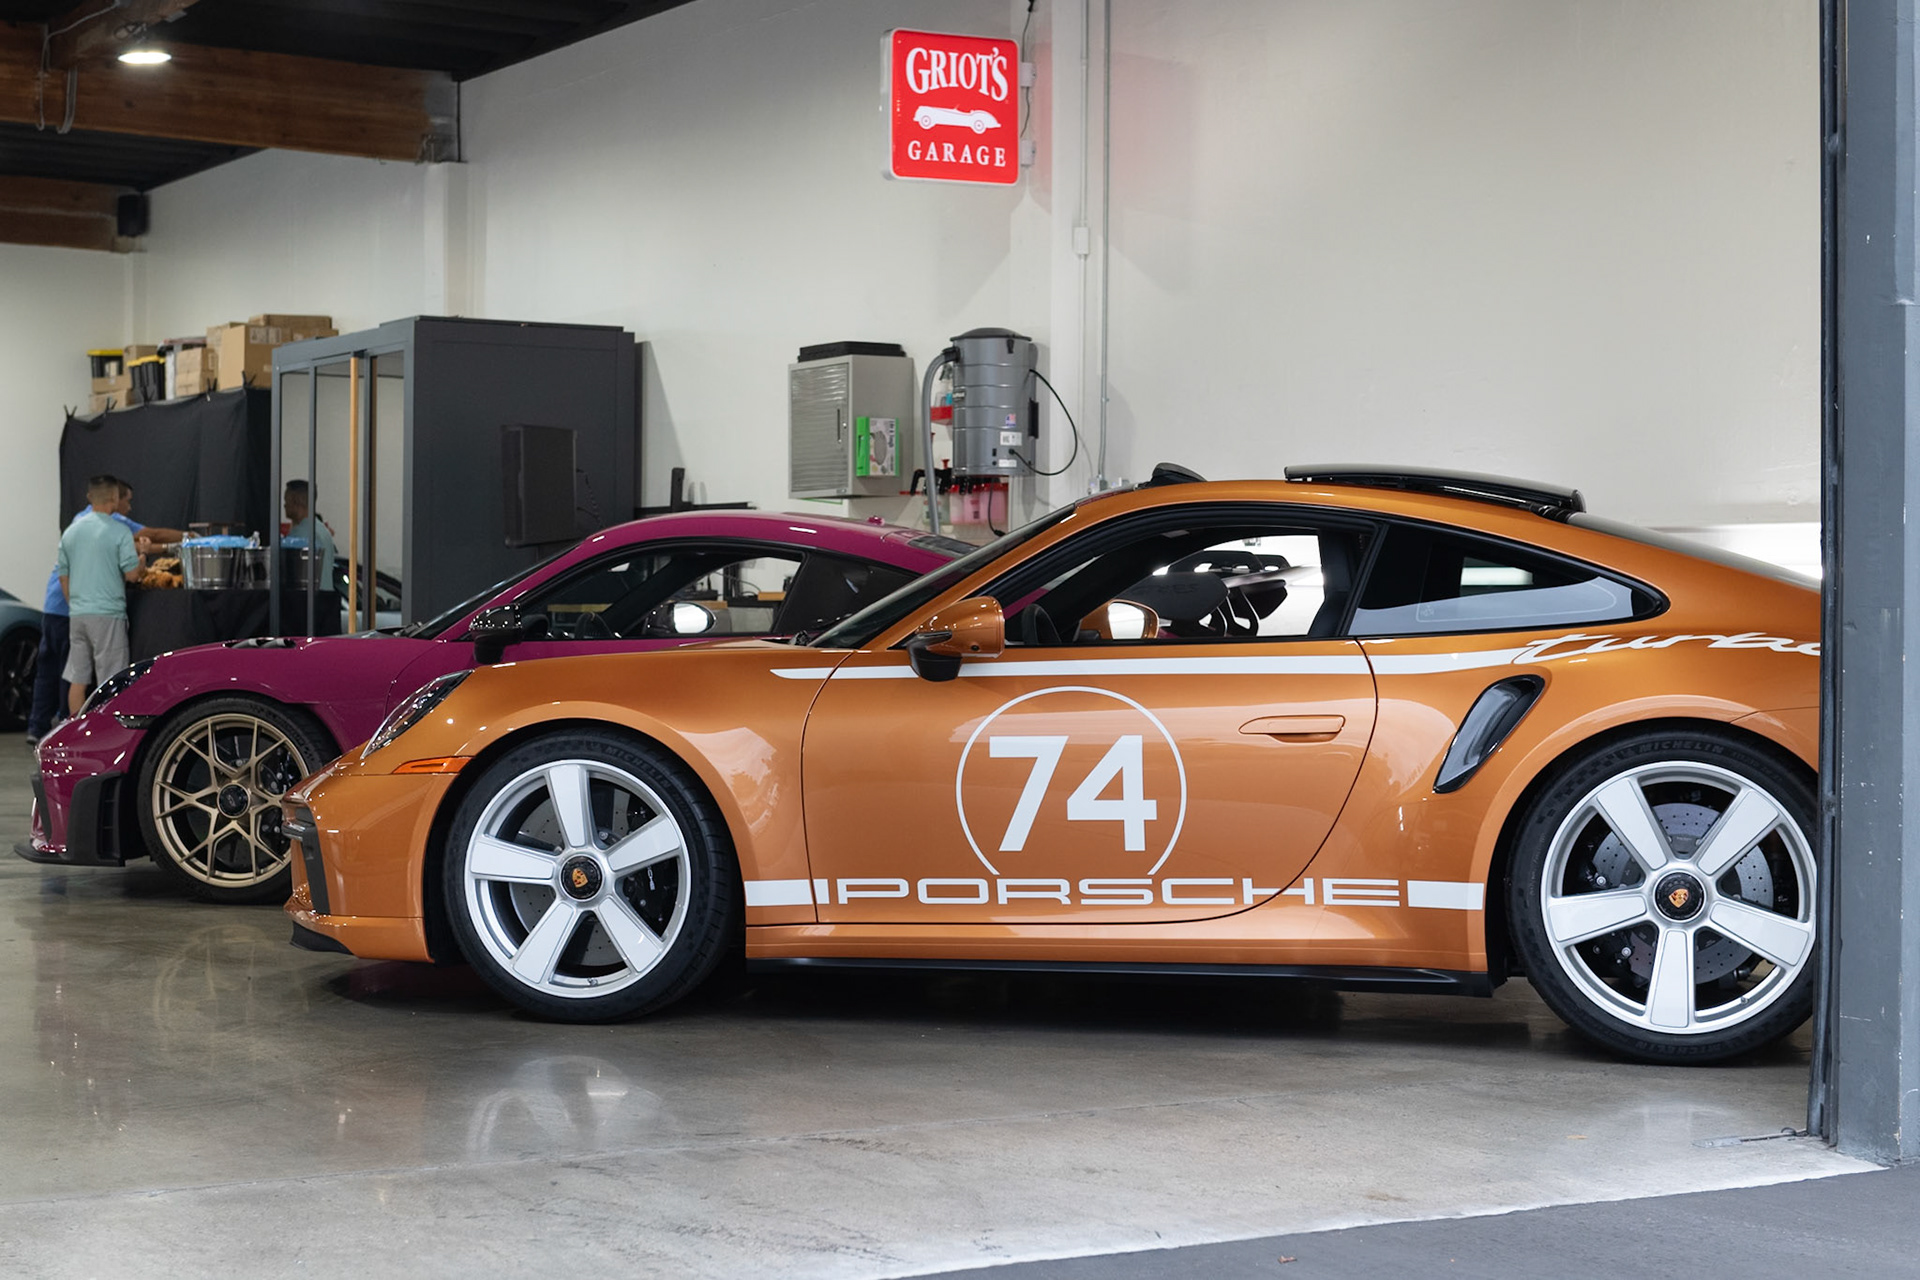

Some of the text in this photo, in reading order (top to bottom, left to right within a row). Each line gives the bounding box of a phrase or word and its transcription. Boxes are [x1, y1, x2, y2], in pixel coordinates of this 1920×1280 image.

[906, 47, 1009, 102] GRIOT'S
[907, 139, 1006, 168] GARAGE
[1638, 739, 1726, 755] MICHELIN
[604, 746, 672, 789] MICHELIN
[989, 735, 1158, 852] 74
[836, 877, 1400, 906] PORSCHE
